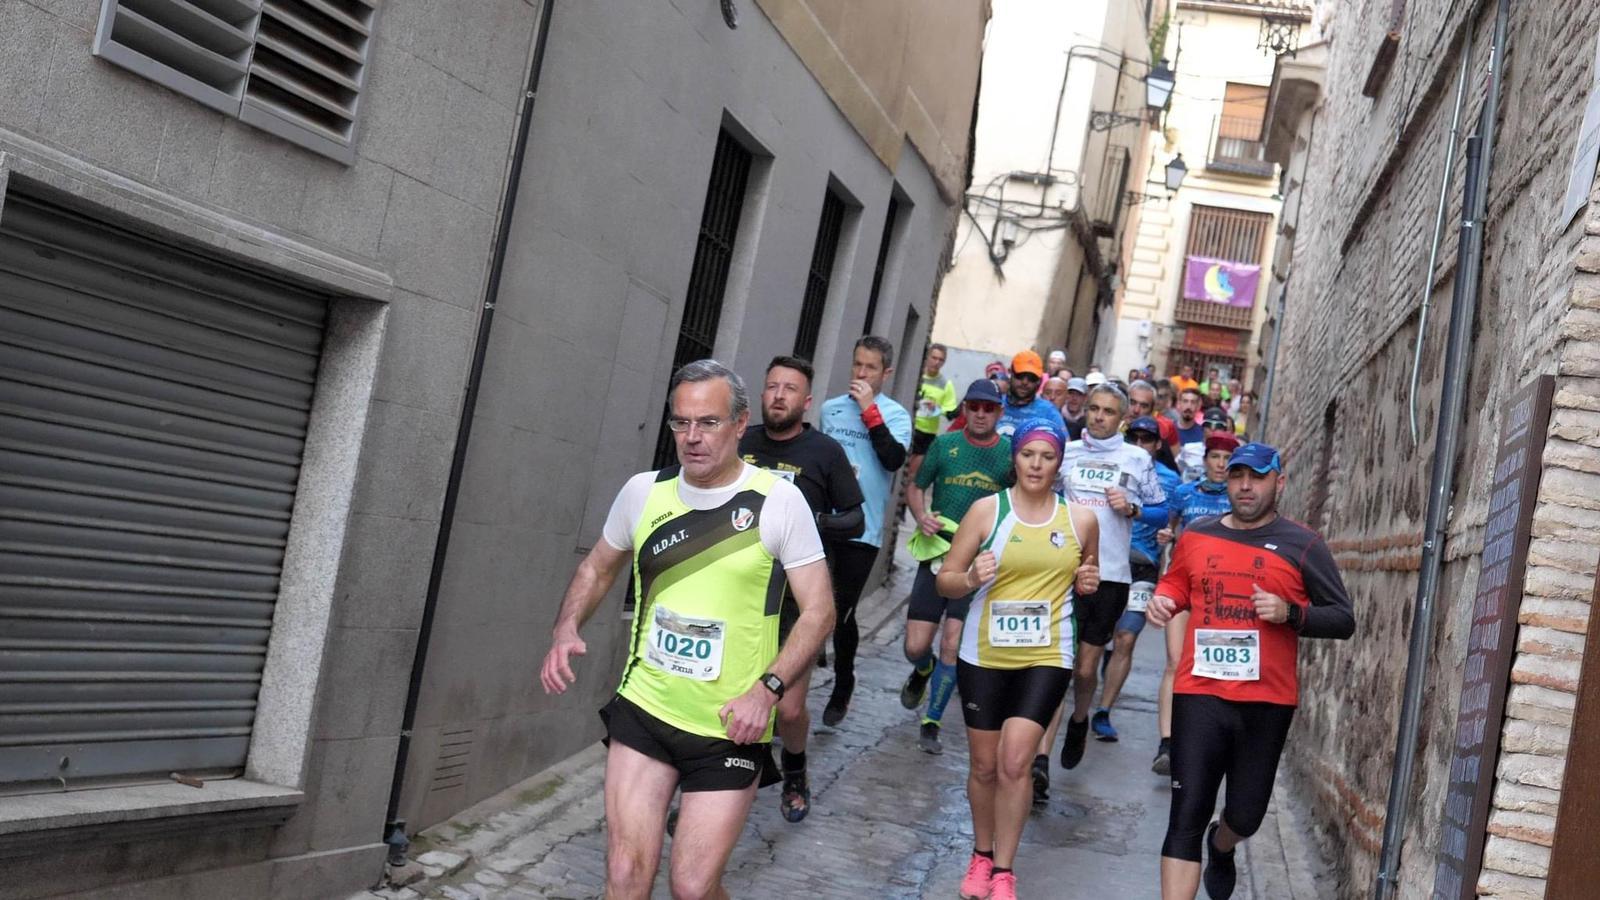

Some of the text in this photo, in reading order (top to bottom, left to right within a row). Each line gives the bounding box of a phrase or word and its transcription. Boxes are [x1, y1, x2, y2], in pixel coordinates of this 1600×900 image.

[1079, 469, 1114, 482] 1042
[652, 529, 689, 555] U.D.A.T.
[996, 617, 1040, 631] 1011
[656, 629, 712, 660] 1020
[1203, 647, 1251, 663] 1083
